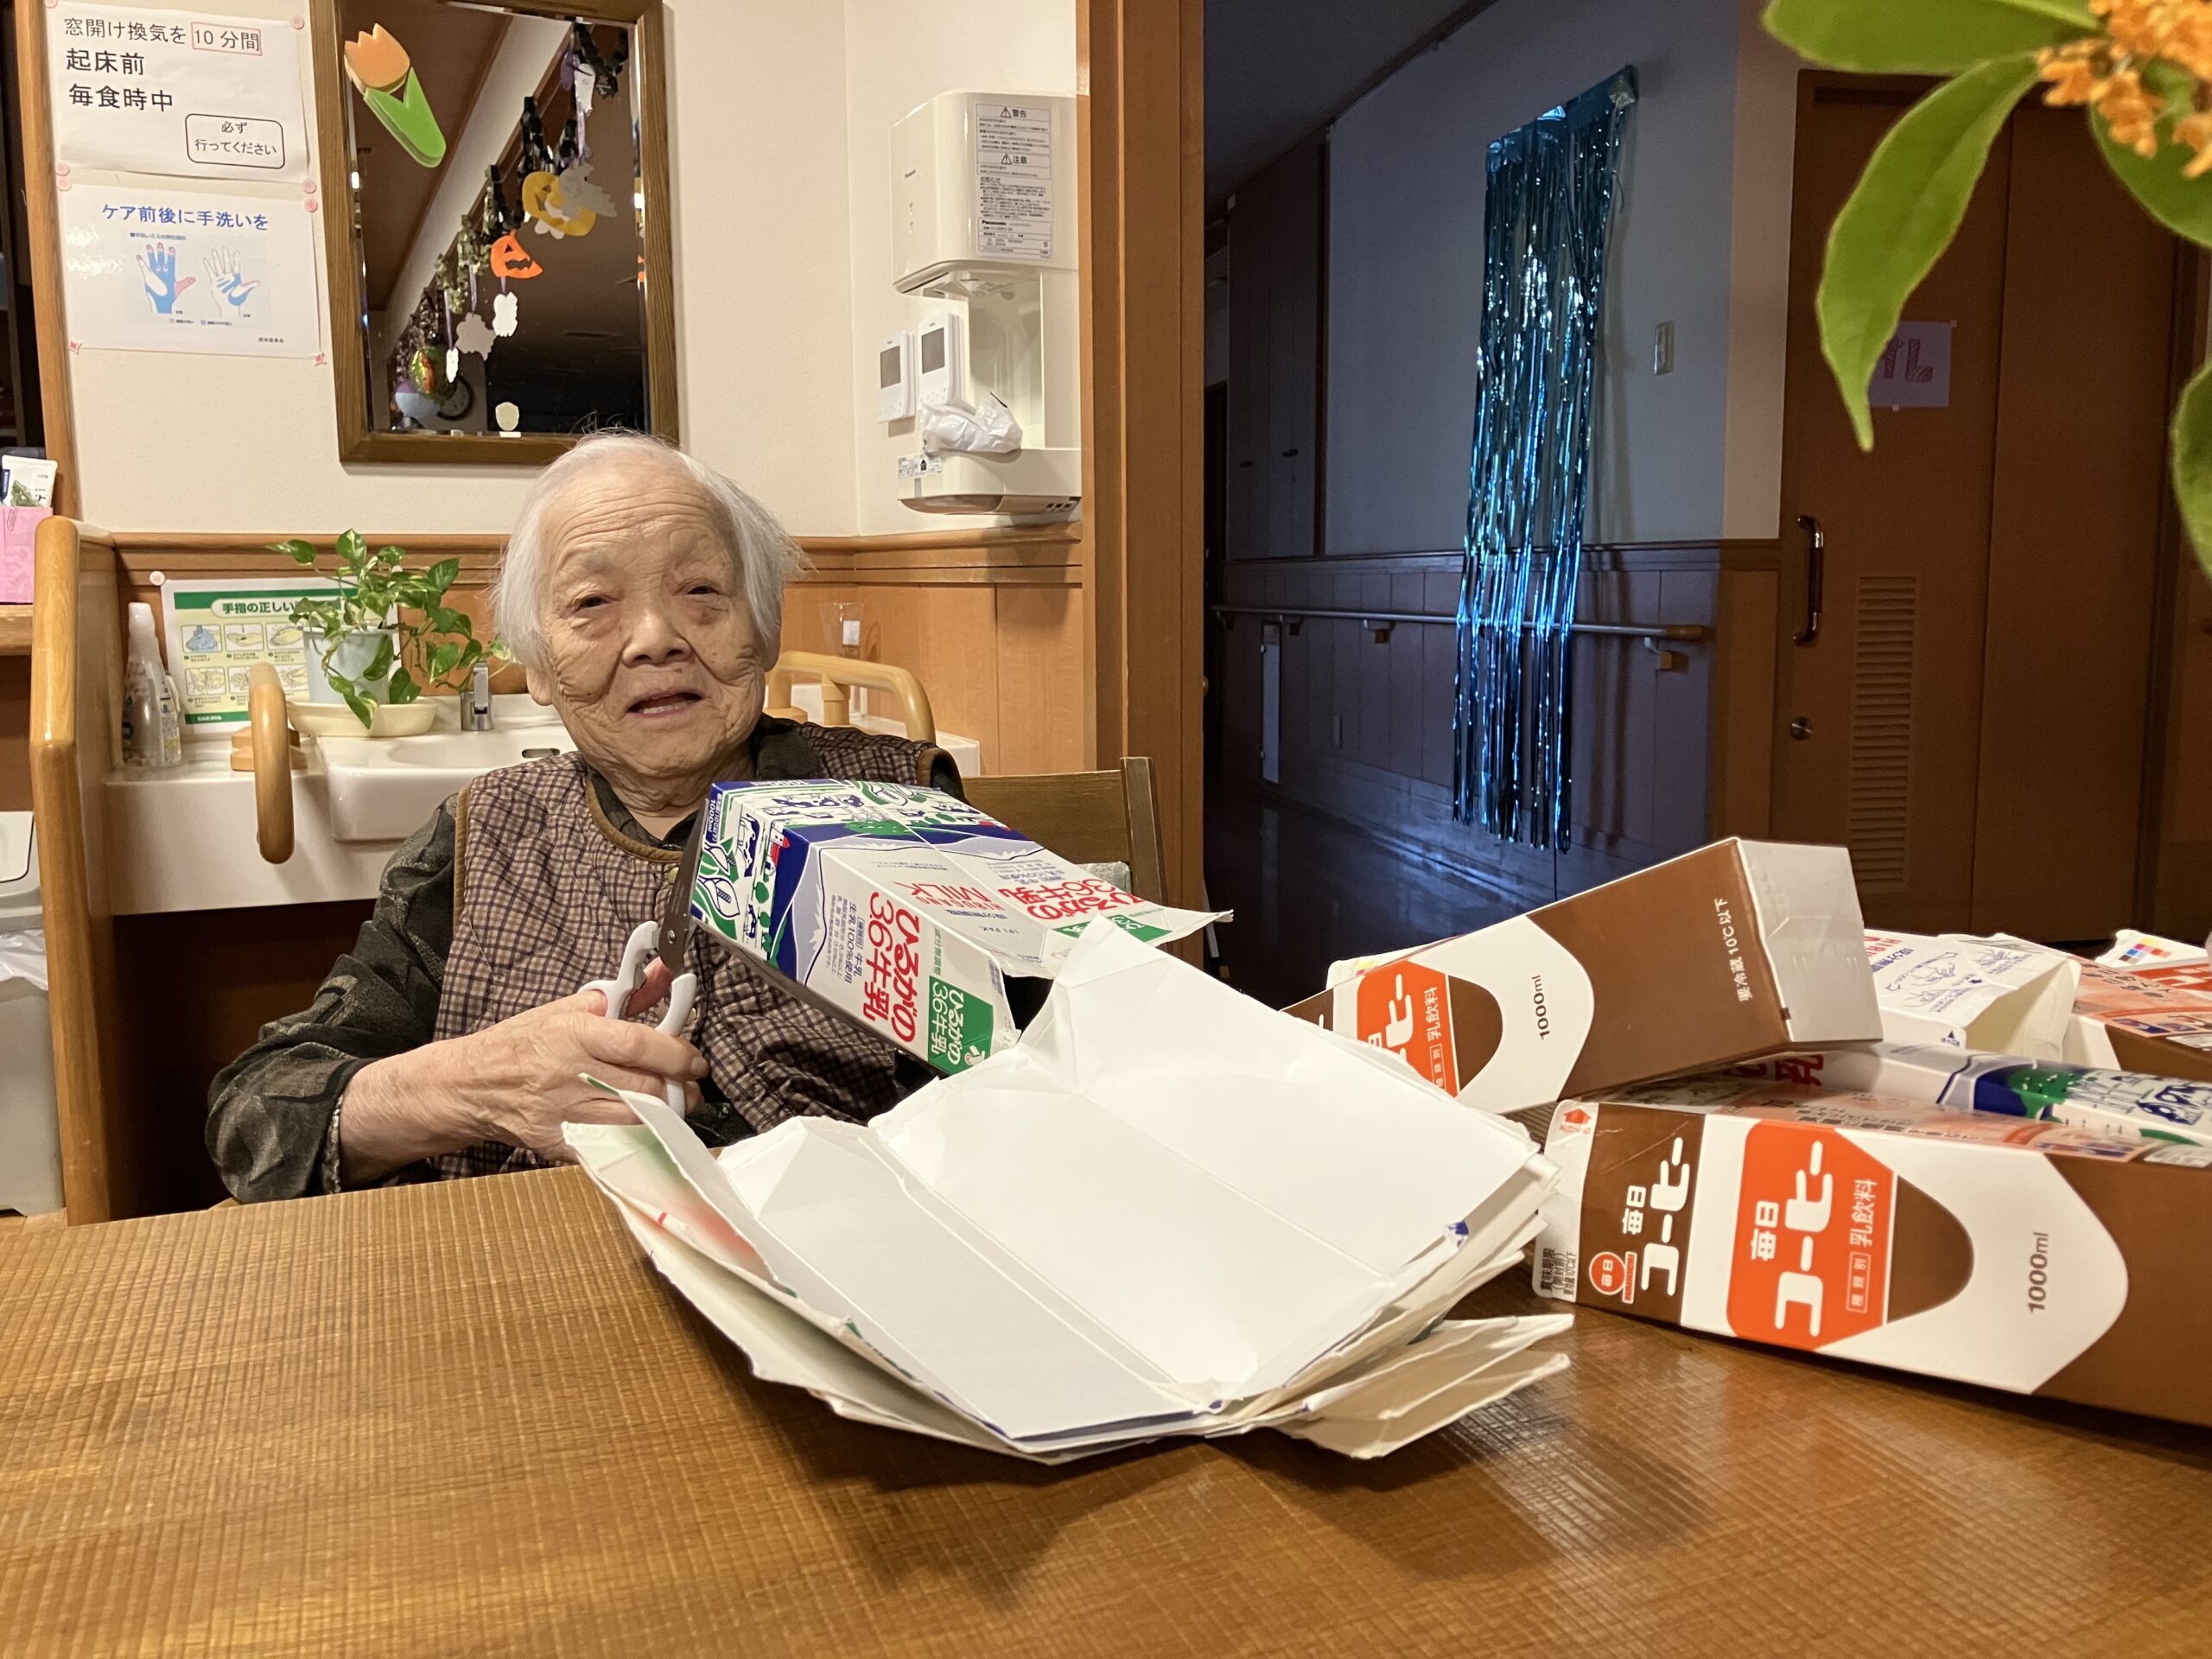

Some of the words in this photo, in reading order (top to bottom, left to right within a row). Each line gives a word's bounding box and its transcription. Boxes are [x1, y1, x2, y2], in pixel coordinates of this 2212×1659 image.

[64, 17, 187, 45] 窓開け換気を
[66, 48, 145, 76] 起床前
[68, 83, 174, 112] 毎食時中
[194, 138, 277, 156] 行ってください
[221, 121, 248, 135] 必ず
[101, 203, 270, 232] ケア前後に手洗いを
[222, 601, 296, 614] 手指の正しい
[893, 880, 992, 902] MILK
[854, 953, 863, 977] 牛乳
[891, 908, 920, 1043] ひるがの
[948, 989, 965, 1065] ひるがの
[1423, 987, 1442, 1042] 乳飲料
[1531, 975, 1551, 1040] 1000ml
[1622, 1185, 1647, 1236] 毎日
[1641, 1136, 1690, 1296] コーヒー
[1751, 1199, 1779, 1262] 毎日
[1849, 1179, 1878, 1247] 乳飲料
[1775, 1140, 1834, 1338] コーヒー
[1601, 1259, 1613, 1287] 毎日
[2027, 1231, 2050, 1313] 1000ml
